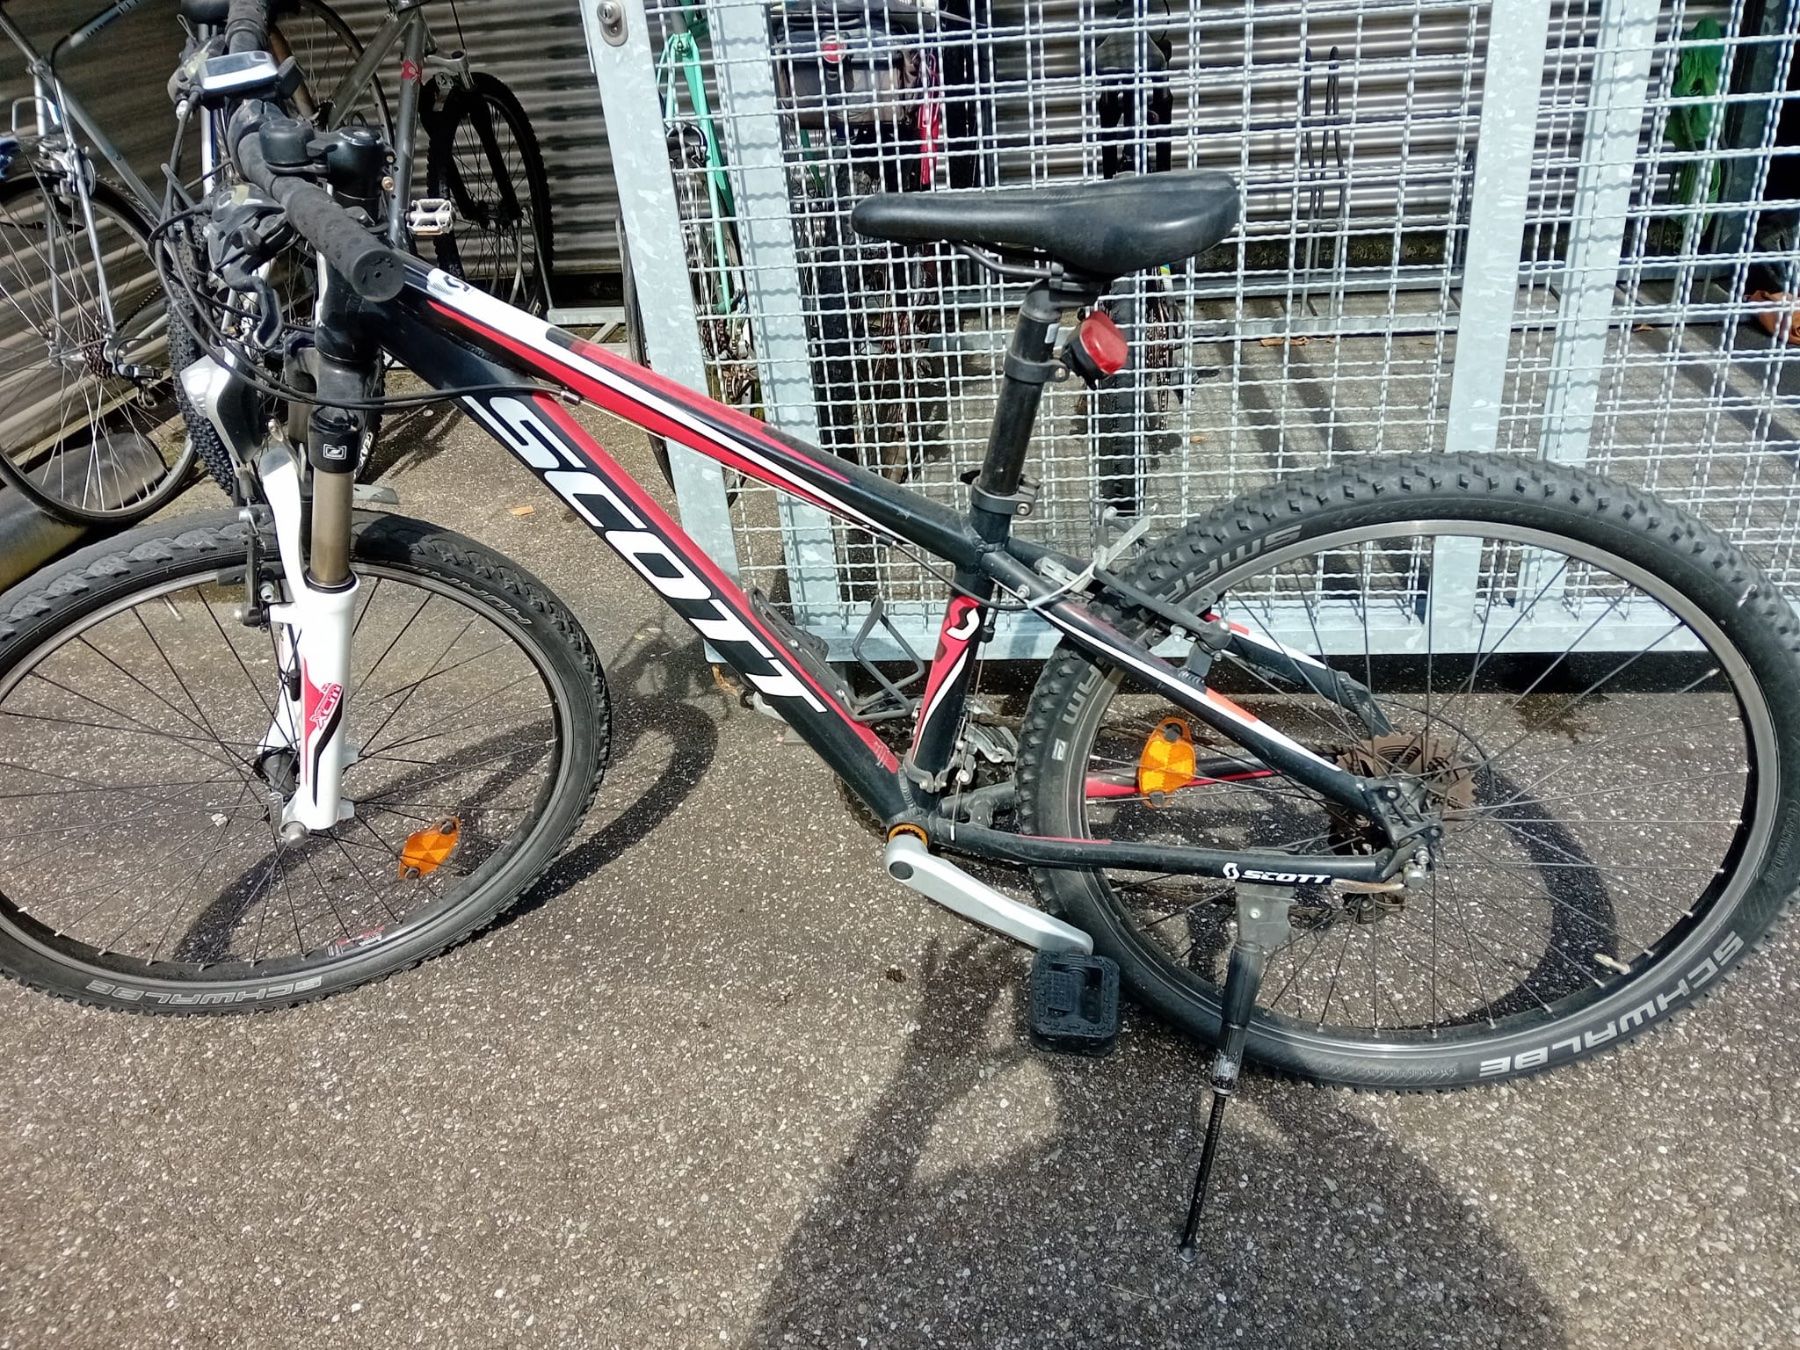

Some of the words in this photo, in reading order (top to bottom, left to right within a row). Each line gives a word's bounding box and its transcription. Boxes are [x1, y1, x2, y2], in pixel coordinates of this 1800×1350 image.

[463, 396, 828, 713] SCOTT
[1062, 660, 1104, 725] AM
[1241, 869, 1332, 885] SCOTT
[86, 976, 323, 1006] SCHWALBE
[1479, 931, 1744, 1077] SCHWALBE
